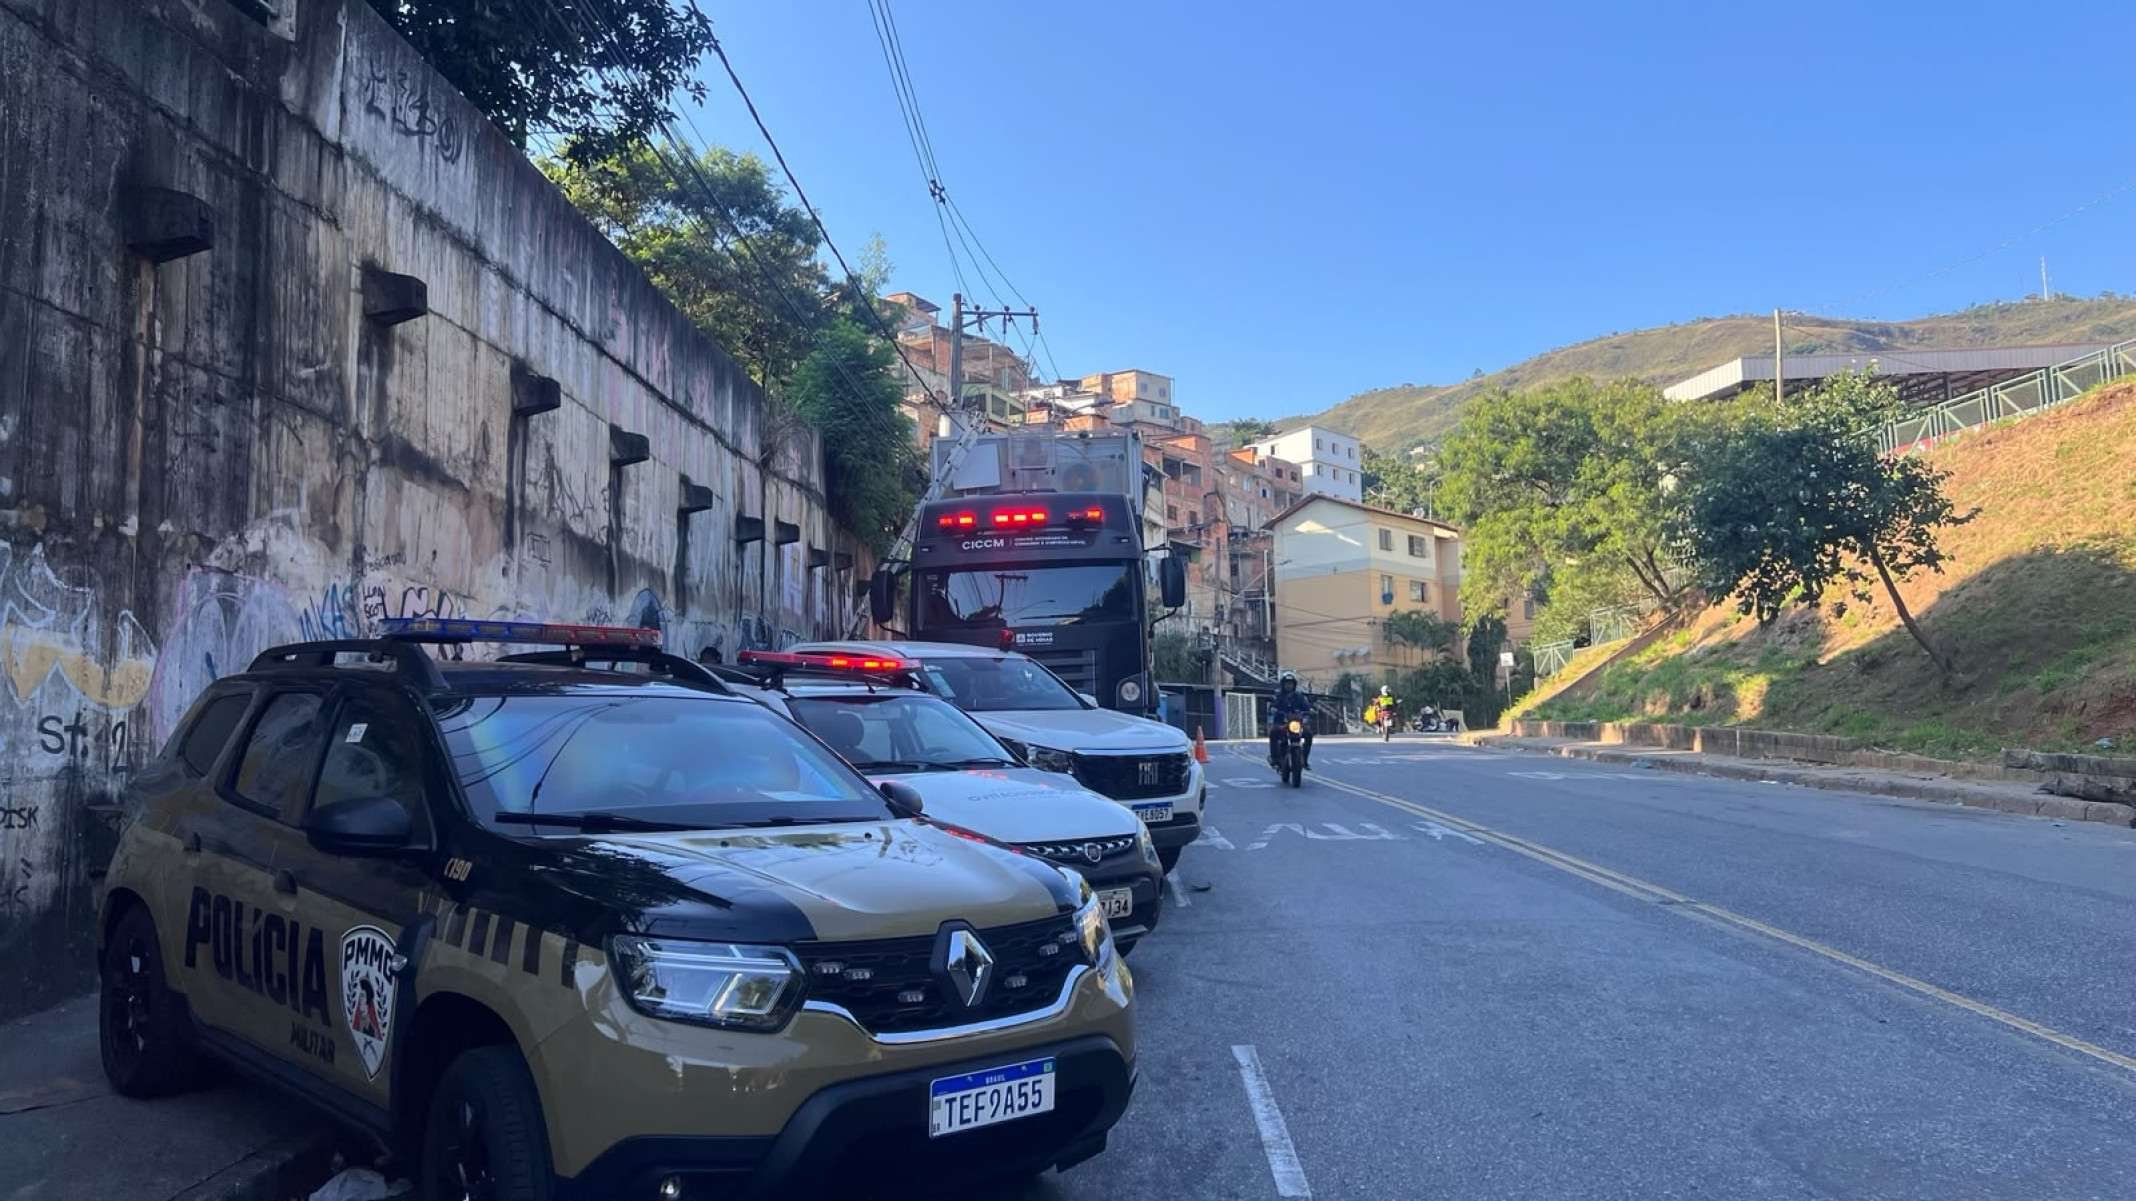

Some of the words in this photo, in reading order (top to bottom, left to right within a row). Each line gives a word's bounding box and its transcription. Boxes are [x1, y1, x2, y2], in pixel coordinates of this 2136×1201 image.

[962, 538, 1004, 550] CICCM
[1138, 761, 1160, 786] FIAT
[184, 886, 332, 1027] POLÍCIA
[343, 936, 394, 985] PMMG
[945, 1079, 1043, 1128] TEF9A55
